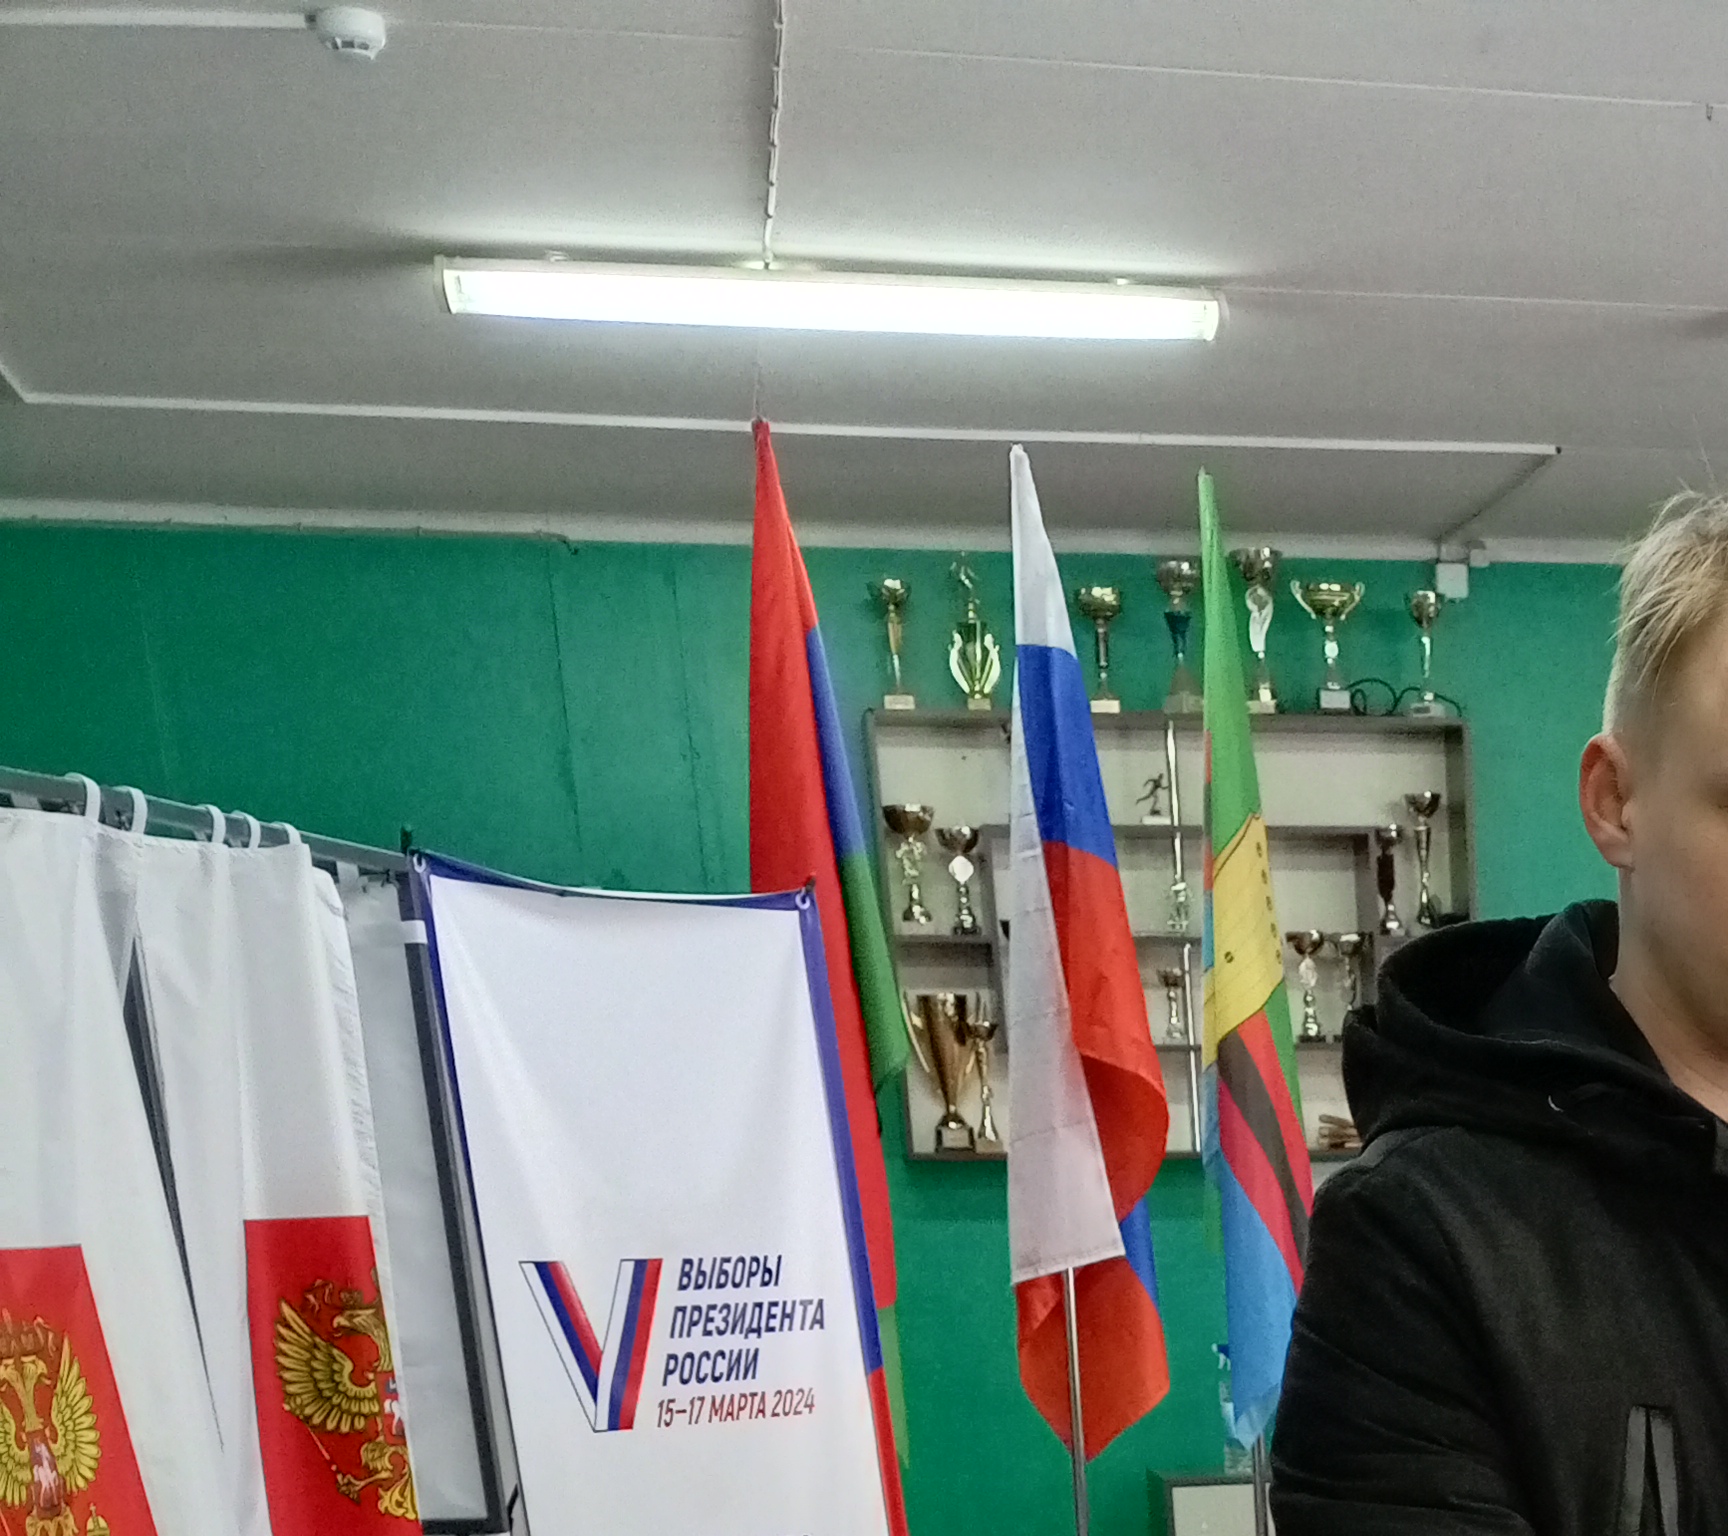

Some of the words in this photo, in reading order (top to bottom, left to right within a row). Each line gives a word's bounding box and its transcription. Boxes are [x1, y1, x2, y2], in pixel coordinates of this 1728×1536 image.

[678, 1254, 782, 1292] ВЫБОРЫ
[669, 1297, 826, 1341] ПРЕЗИДЕНТА
[662, 1347, 758, 1388] РОССИИ
[708, 1391, 767, 1425] МАРТА
[770, 1386, 816, 1419] 2024
